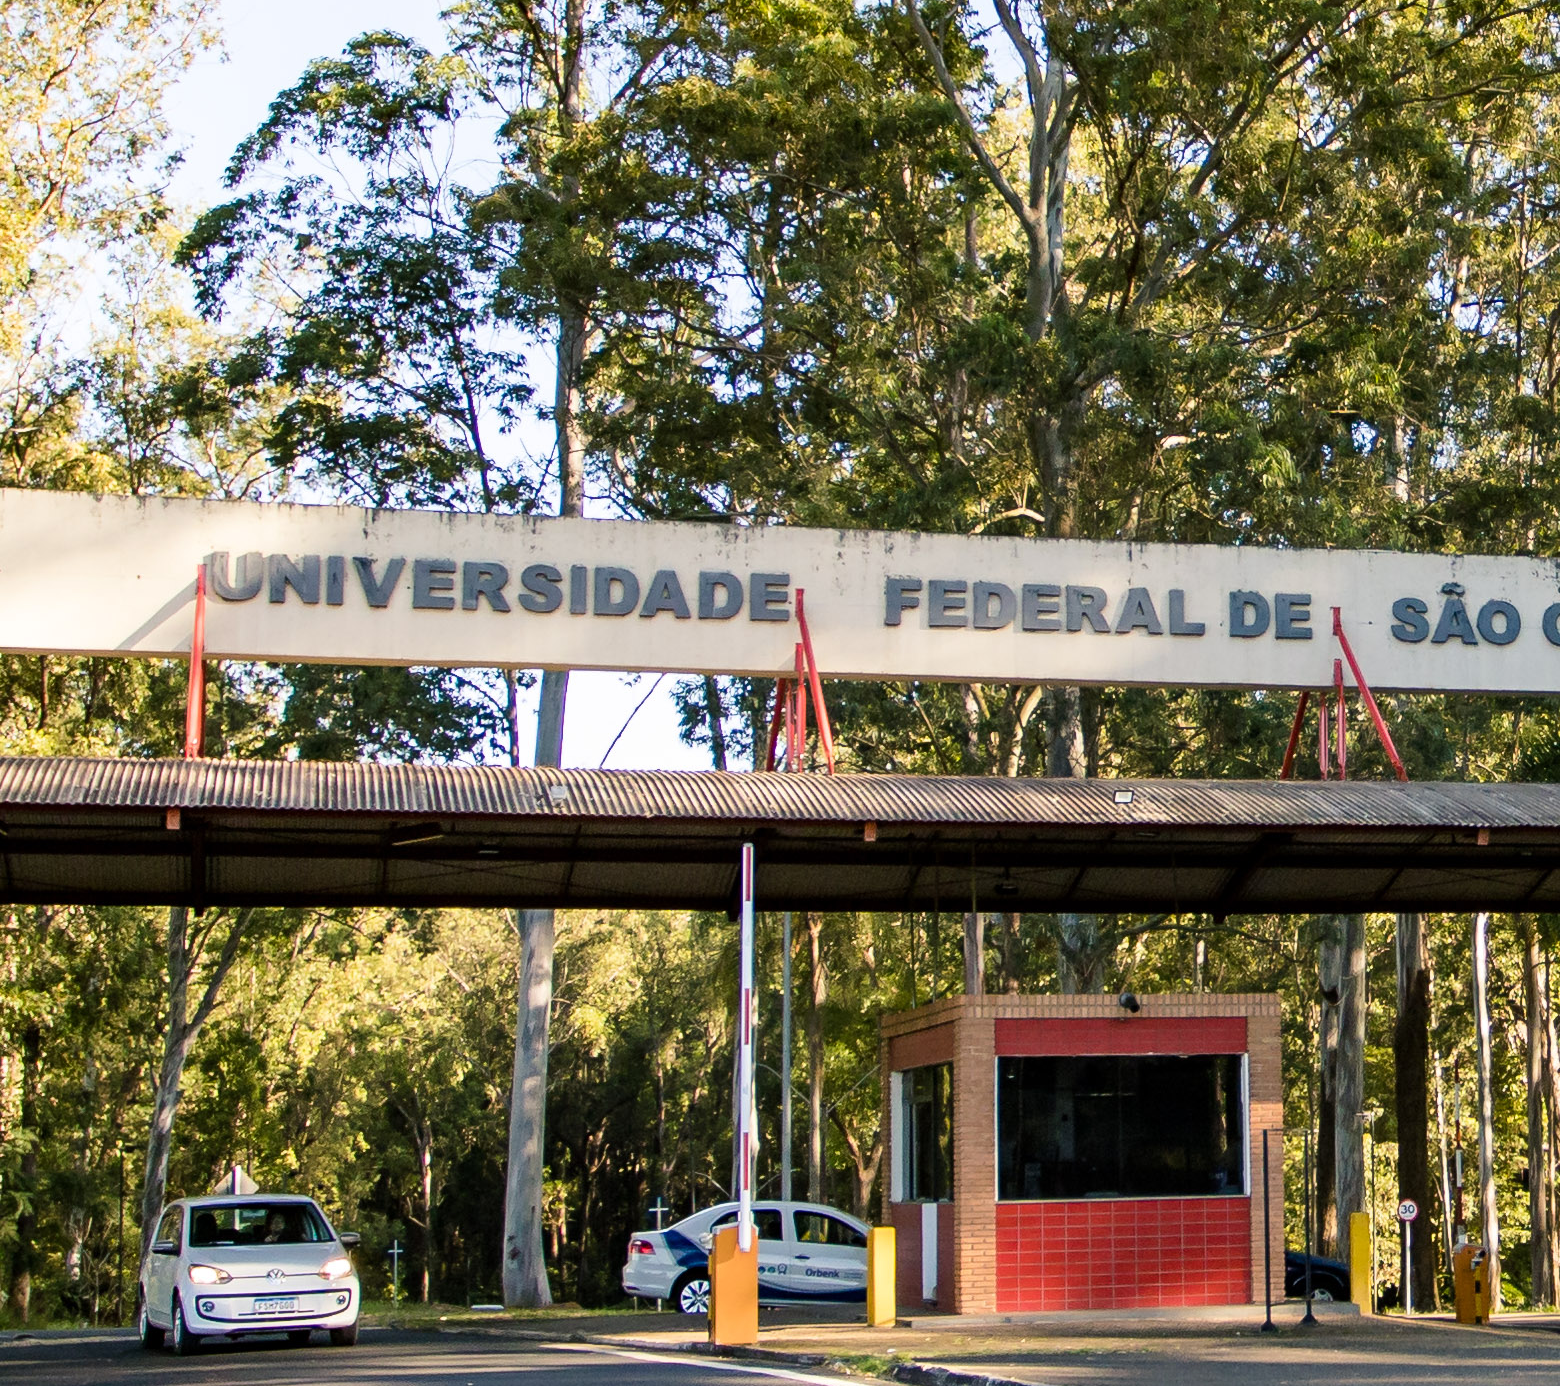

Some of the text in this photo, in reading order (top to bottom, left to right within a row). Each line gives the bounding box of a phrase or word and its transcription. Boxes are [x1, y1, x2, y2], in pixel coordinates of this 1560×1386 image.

[207, 550, 790, 622] UNIVERSIDADE
[884, 577, 1206, 635] FEDERAL
[1228, 590, 1313, 639] DE
[1390, 582, 1522, 646] SÃO
[1400, 1204, 1415, 1215] 30
[805, 1268, 840, 1278] Orbenk
